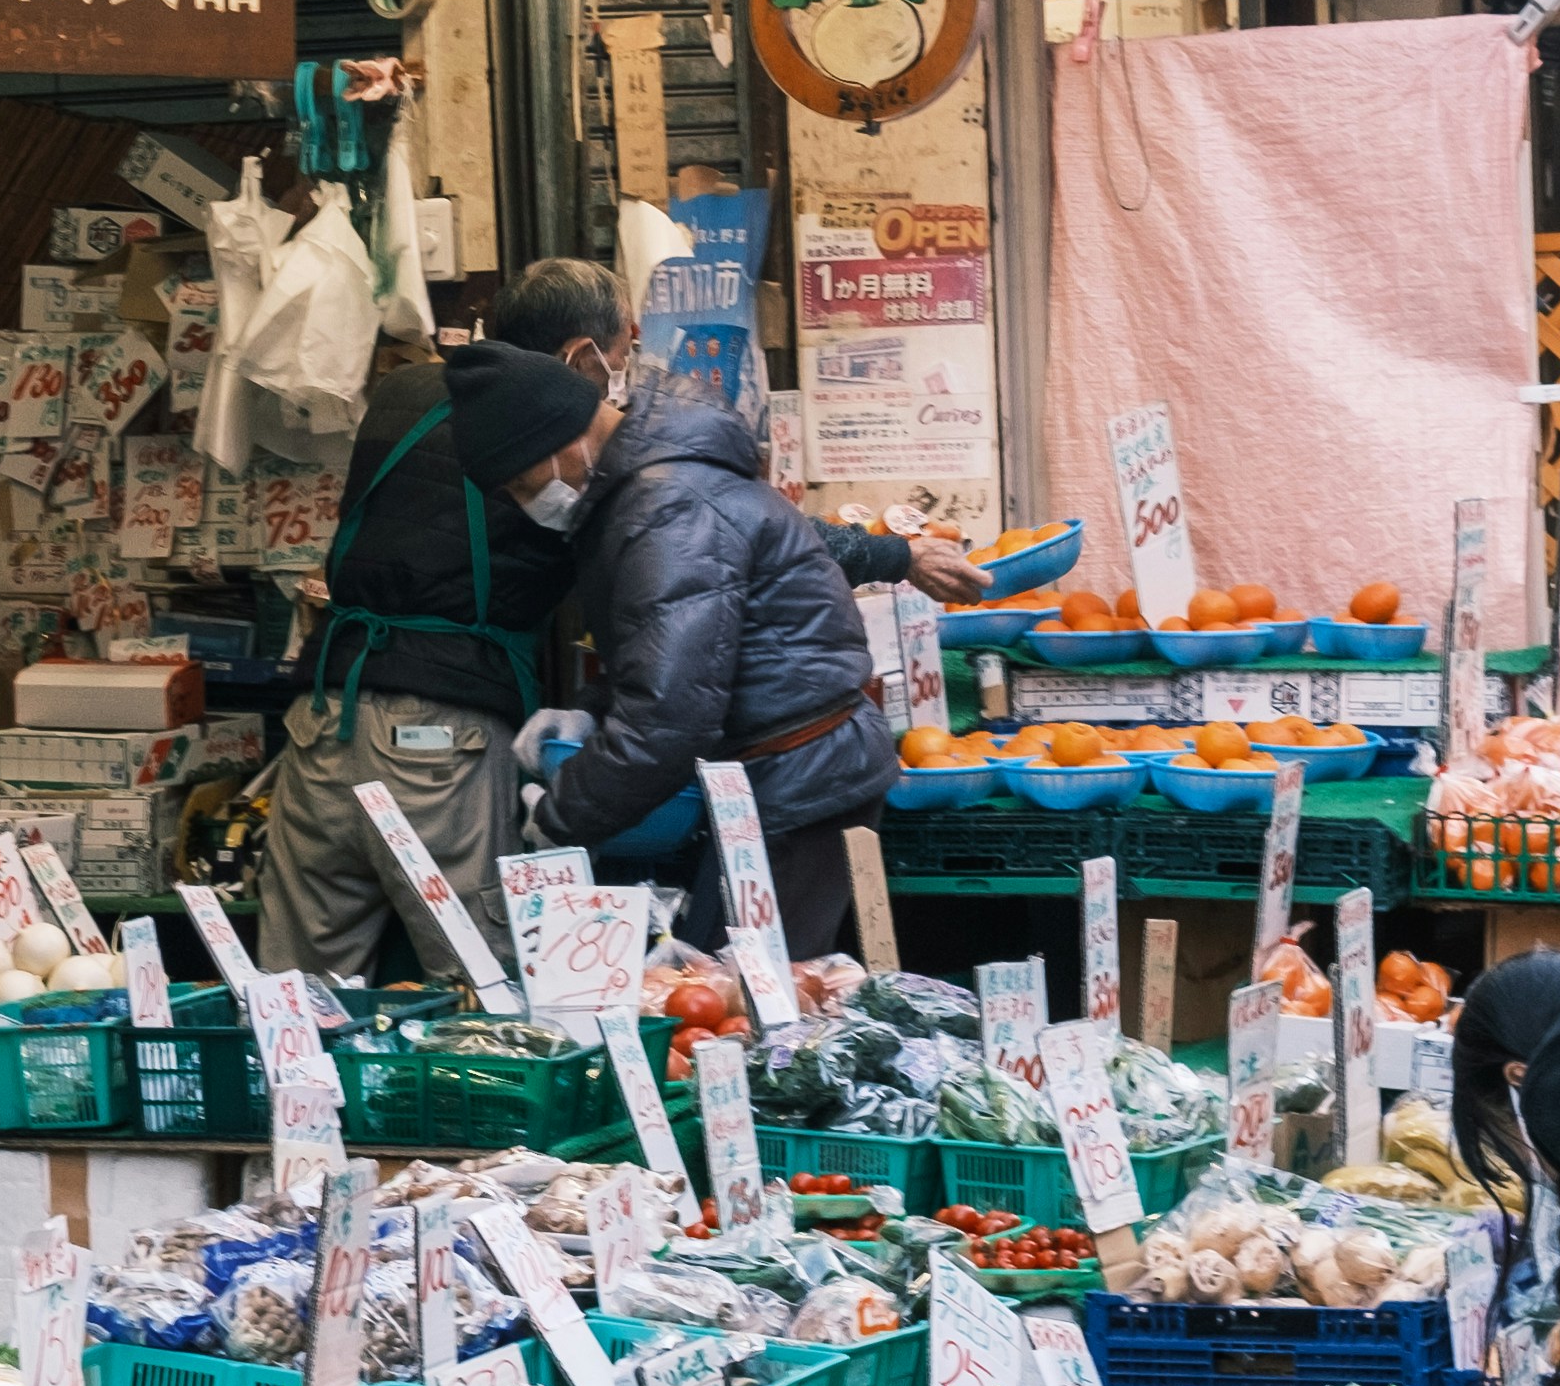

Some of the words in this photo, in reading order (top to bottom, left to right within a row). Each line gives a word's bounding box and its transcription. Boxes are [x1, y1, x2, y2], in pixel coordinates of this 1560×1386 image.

[873, 206, 987, 258] OPEN
[814, 264, 934, 302] 1か月無料
